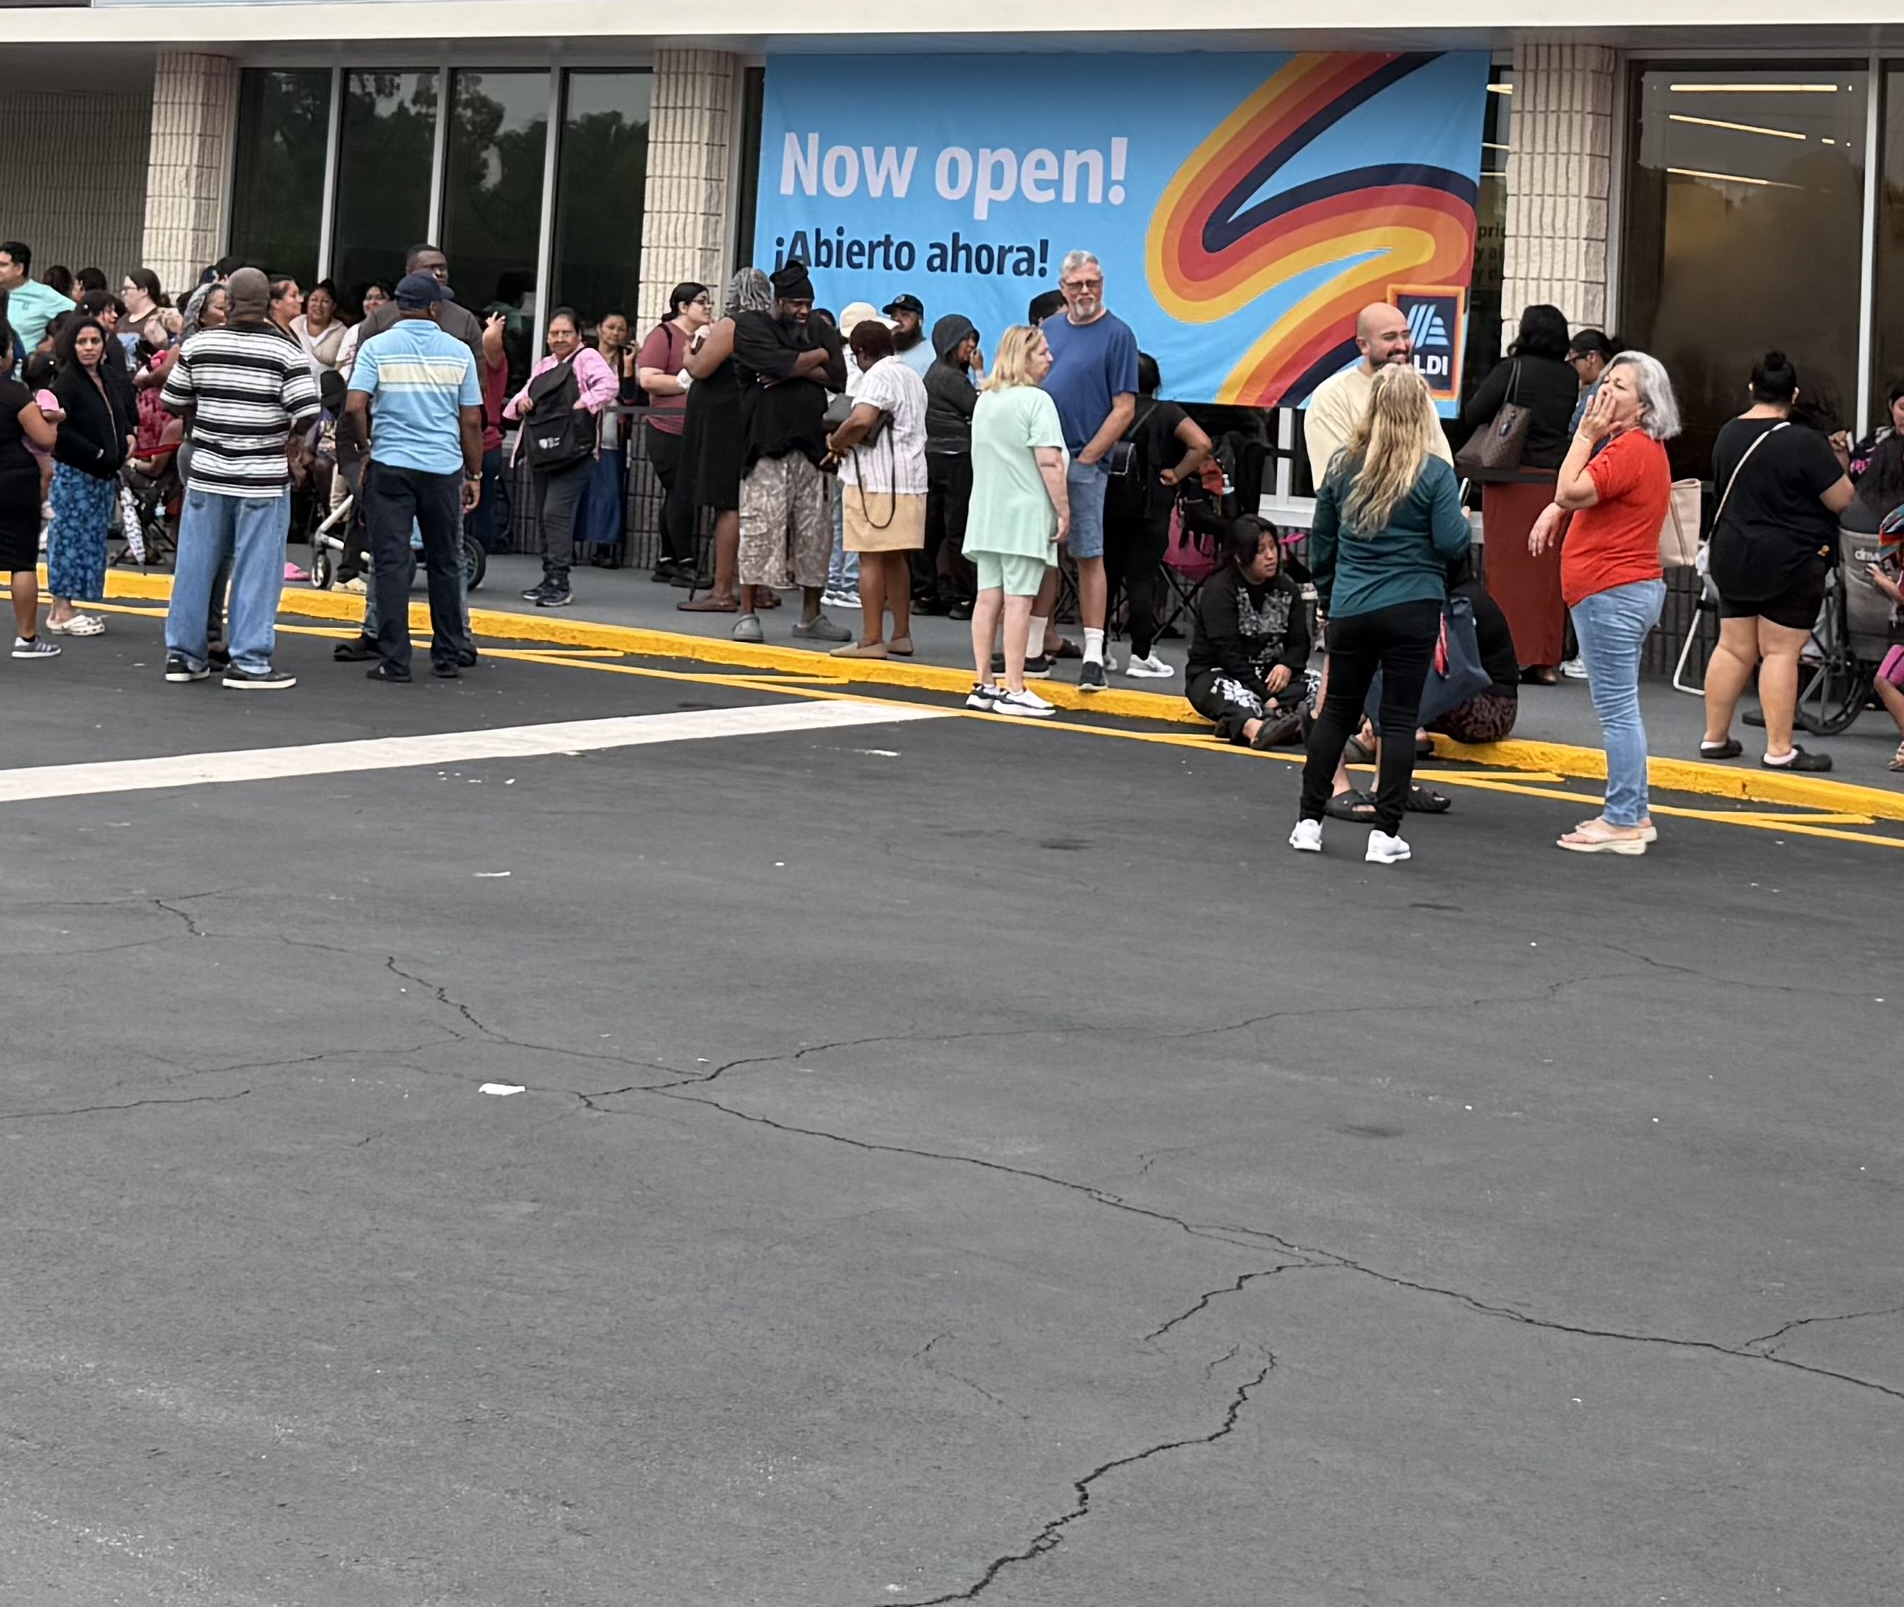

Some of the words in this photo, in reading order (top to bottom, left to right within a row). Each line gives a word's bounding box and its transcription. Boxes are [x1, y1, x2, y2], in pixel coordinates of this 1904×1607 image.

[780, 132, 919, 199] Now
[935, 137, 1128, 221] open!
[774, 225, 916, 272] ¡Abierto
[926, 232, 1049, 278] ahora!
[1414, 354, 1449, 377] LDI
